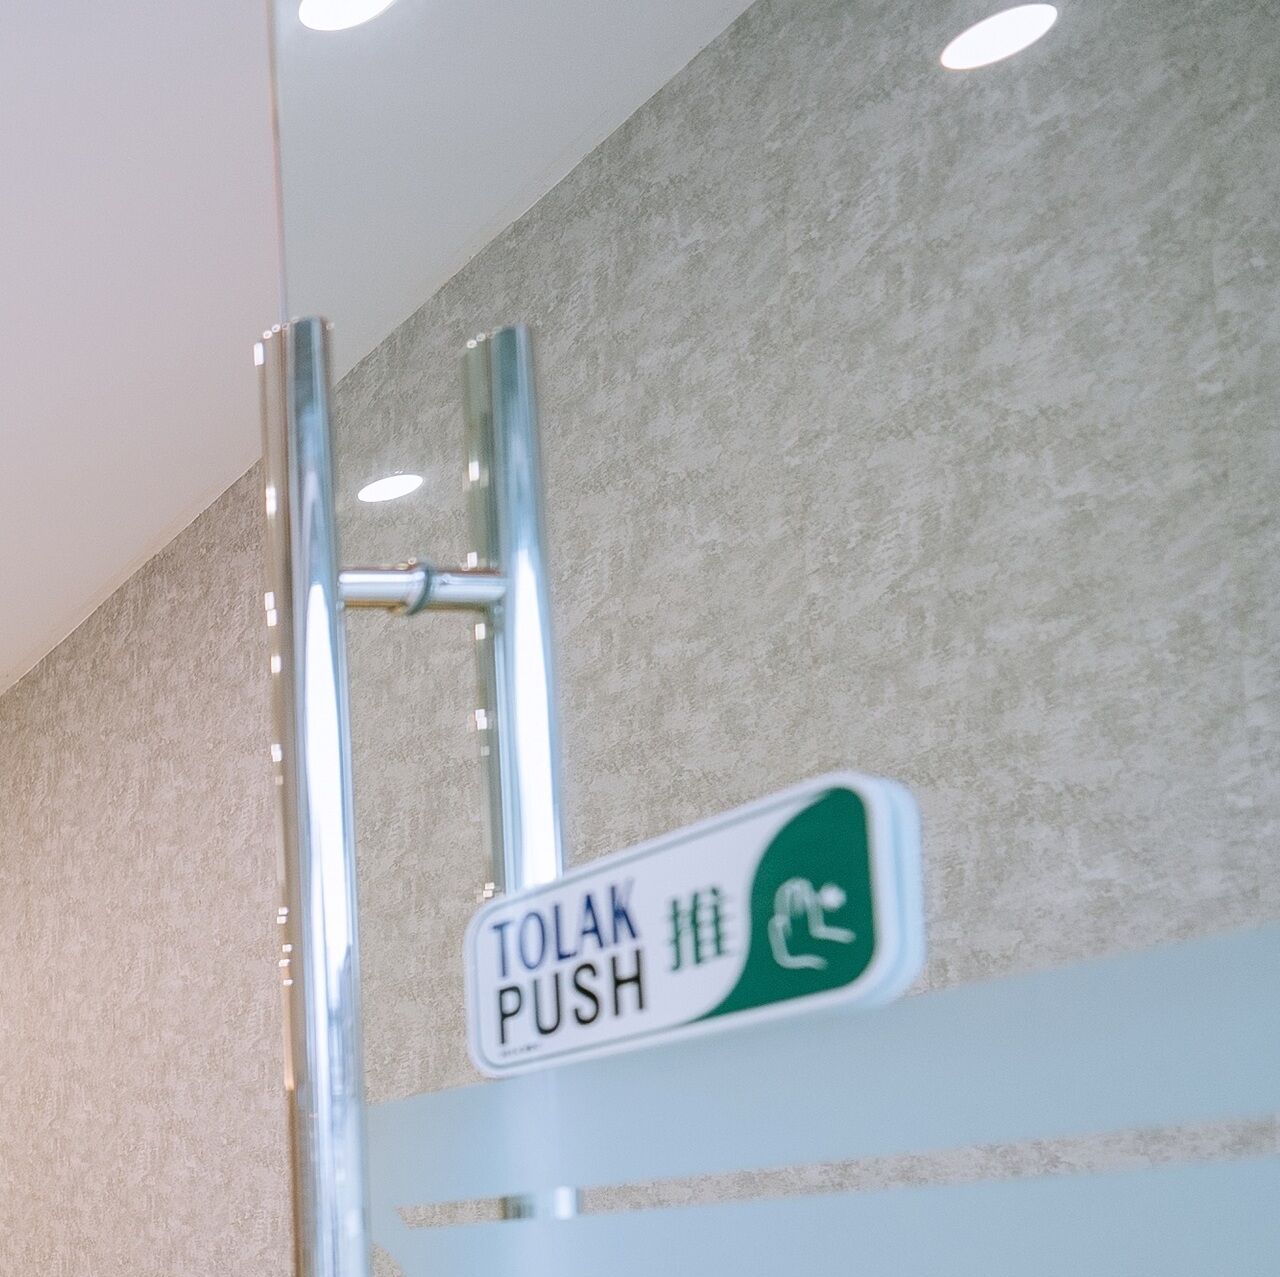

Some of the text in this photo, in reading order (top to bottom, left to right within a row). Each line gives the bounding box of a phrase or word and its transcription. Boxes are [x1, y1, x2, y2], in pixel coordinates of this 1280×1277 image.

[491, 877, 639, 978] TOLAK
[664, 885, 733, 971] 推
[497, 948, 645, 1045] PUSH
